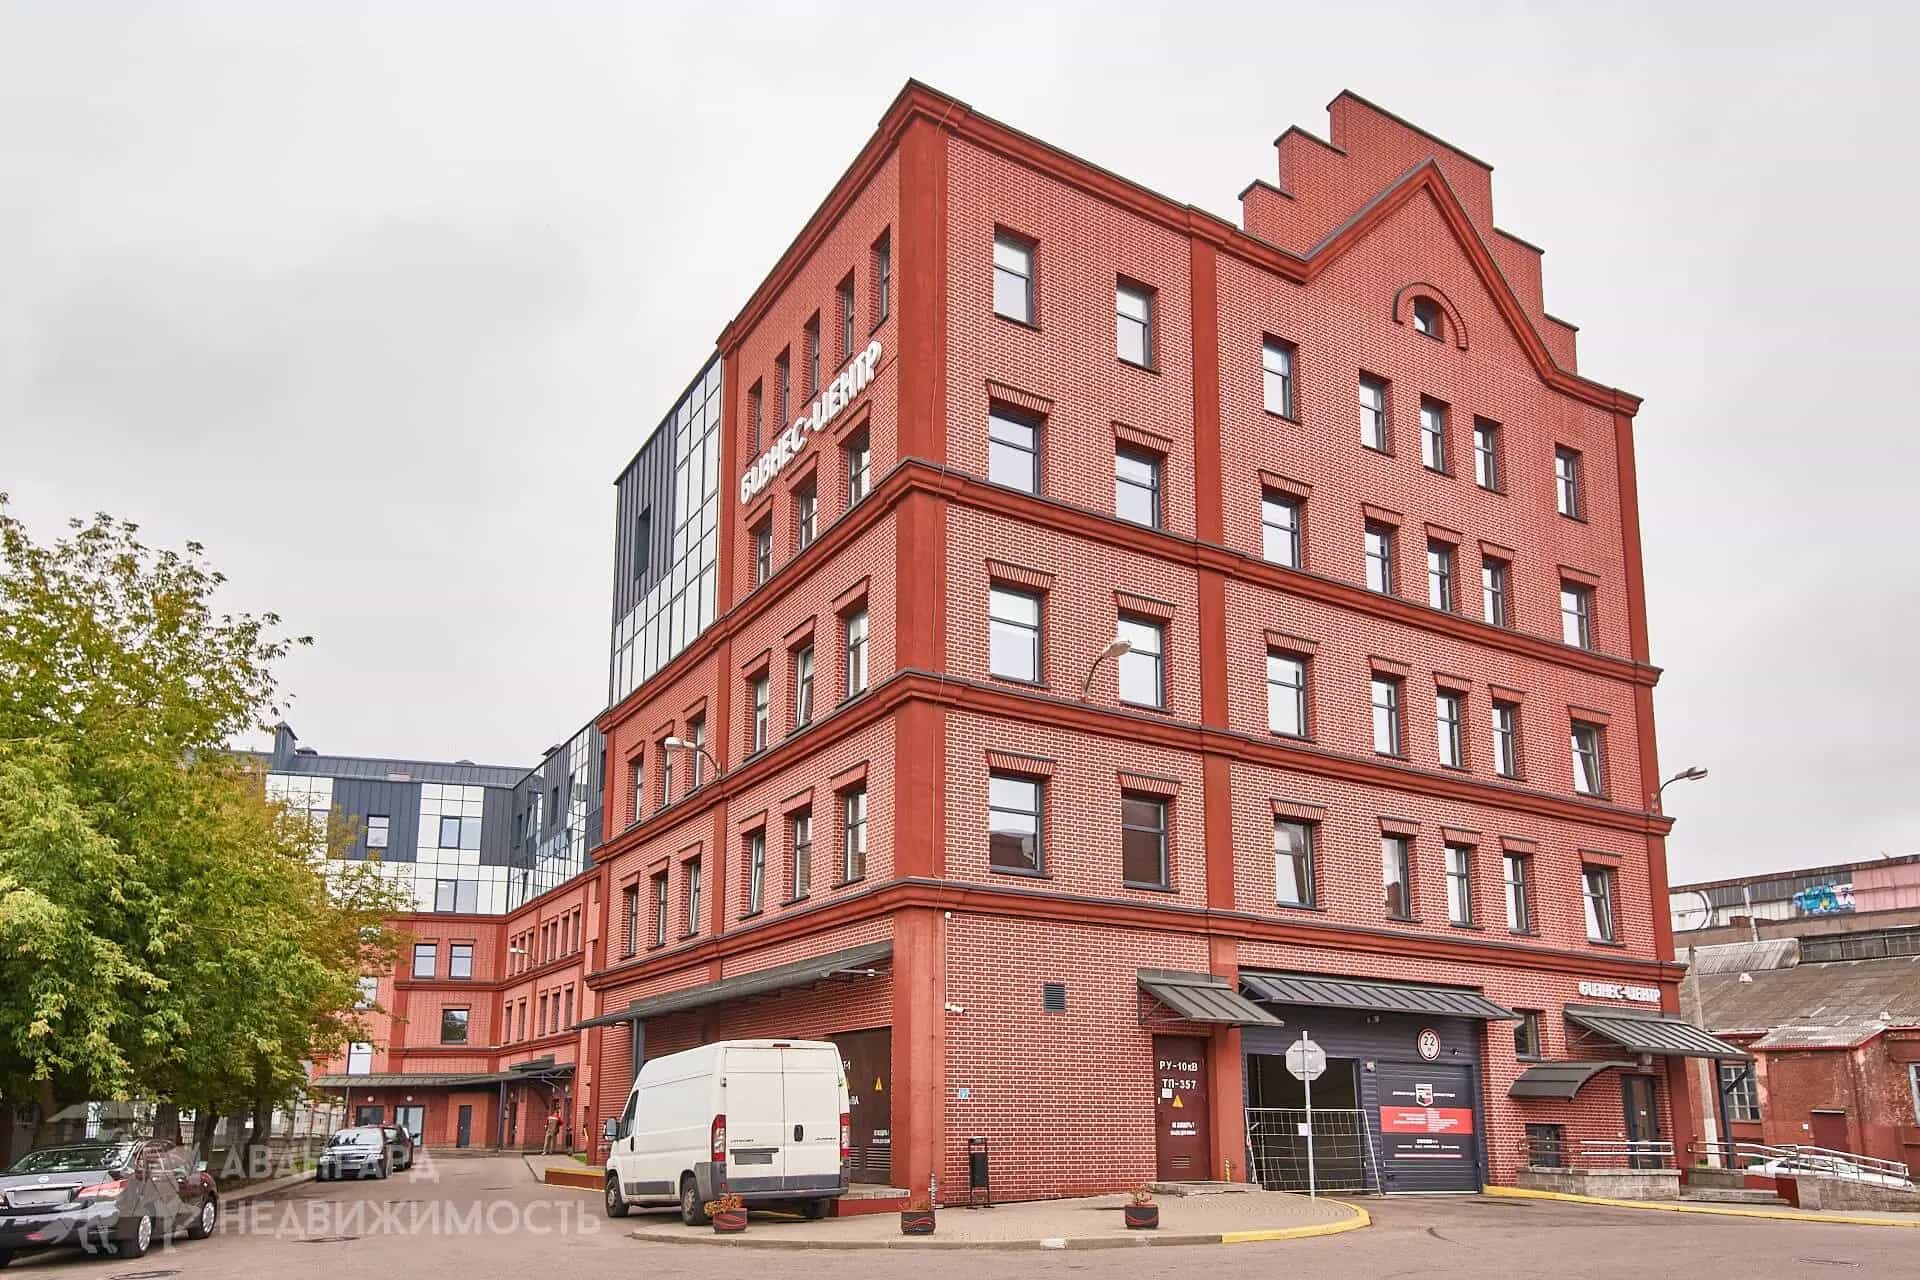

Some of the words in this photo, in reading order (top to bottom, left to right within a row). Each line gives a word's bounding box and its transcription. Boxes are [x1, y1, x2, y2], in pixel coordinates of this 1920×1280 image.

[1423, 1035, 1435, 1046] 22
[1159, 1060, 1198, 1072] РУ-10кВ
[1161, 1078, 1196, 1090] ТП-357
